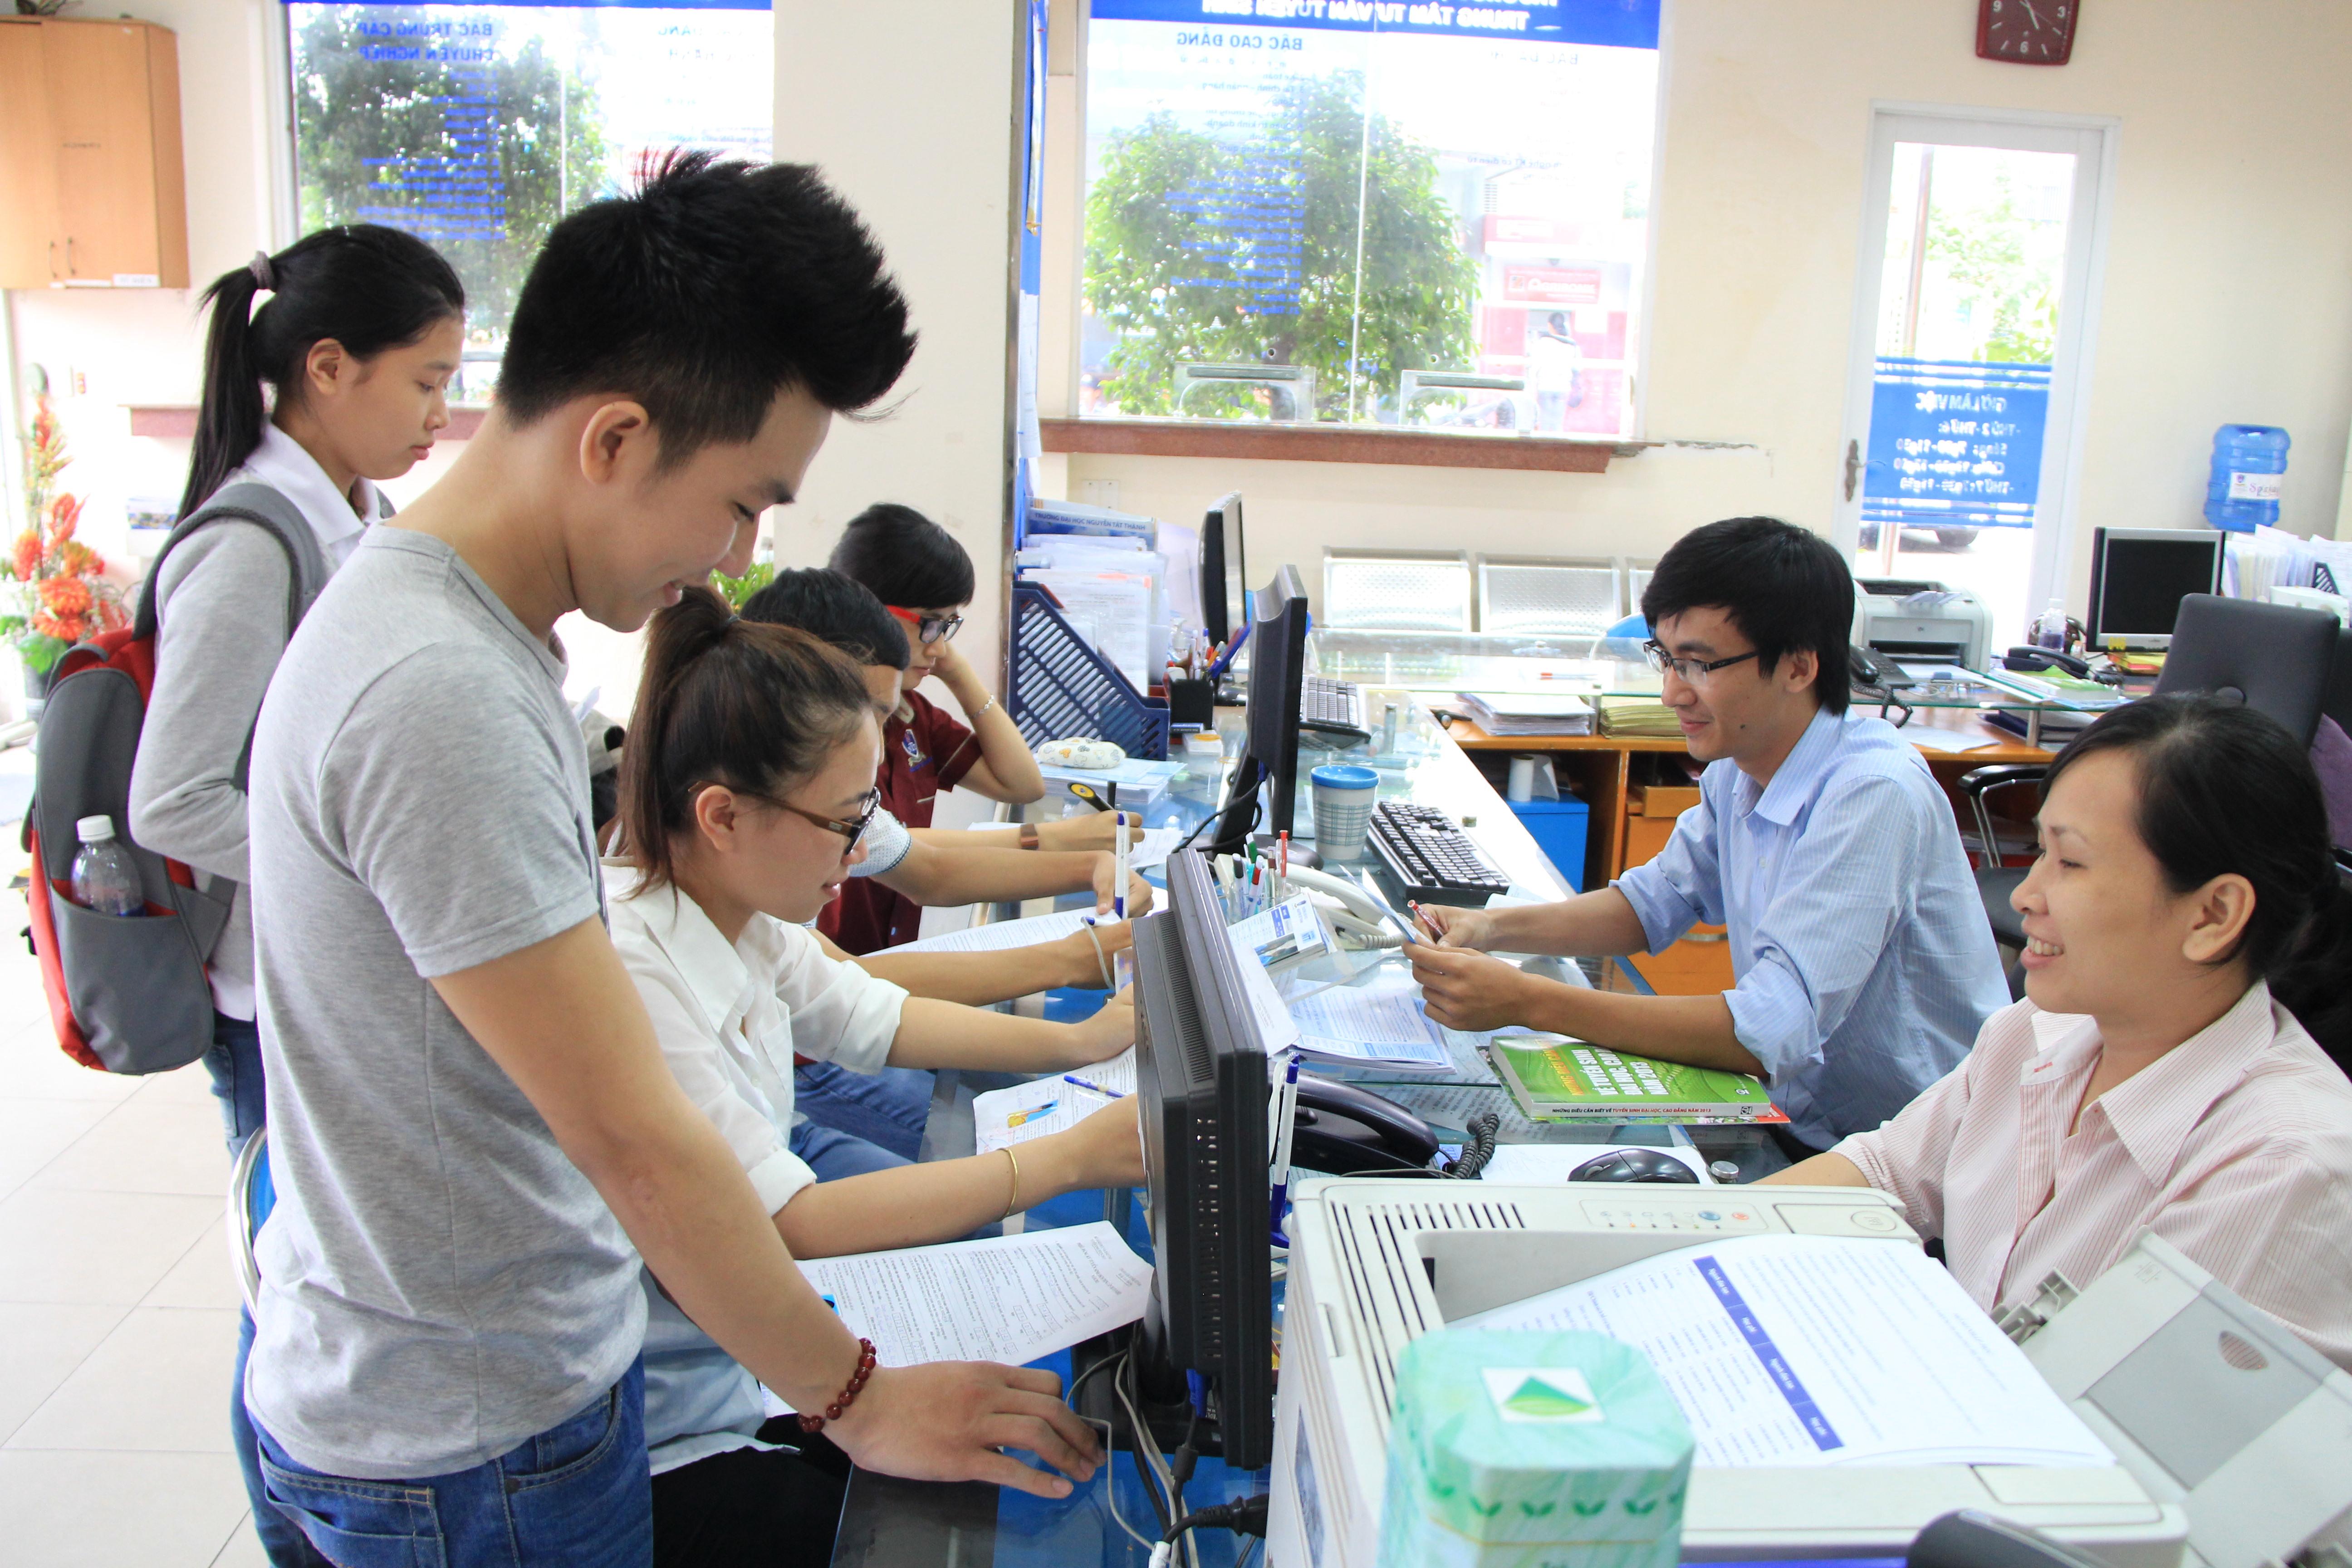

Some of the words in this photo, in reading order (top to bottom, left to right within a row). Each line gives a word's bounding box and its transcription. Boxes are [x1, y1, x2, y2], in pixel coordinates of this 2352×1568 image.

[2057, 5, 2067, 19] 3
[2020, 40, 2030, 54] 6
[1571, 1049, 1598, 1065] SINH
[1629, 1061, 1658, 1079] 2013
[1592, 1086, 1619, 1096] VỀ
[1643, 1079, 1670, 1095] NĂM
